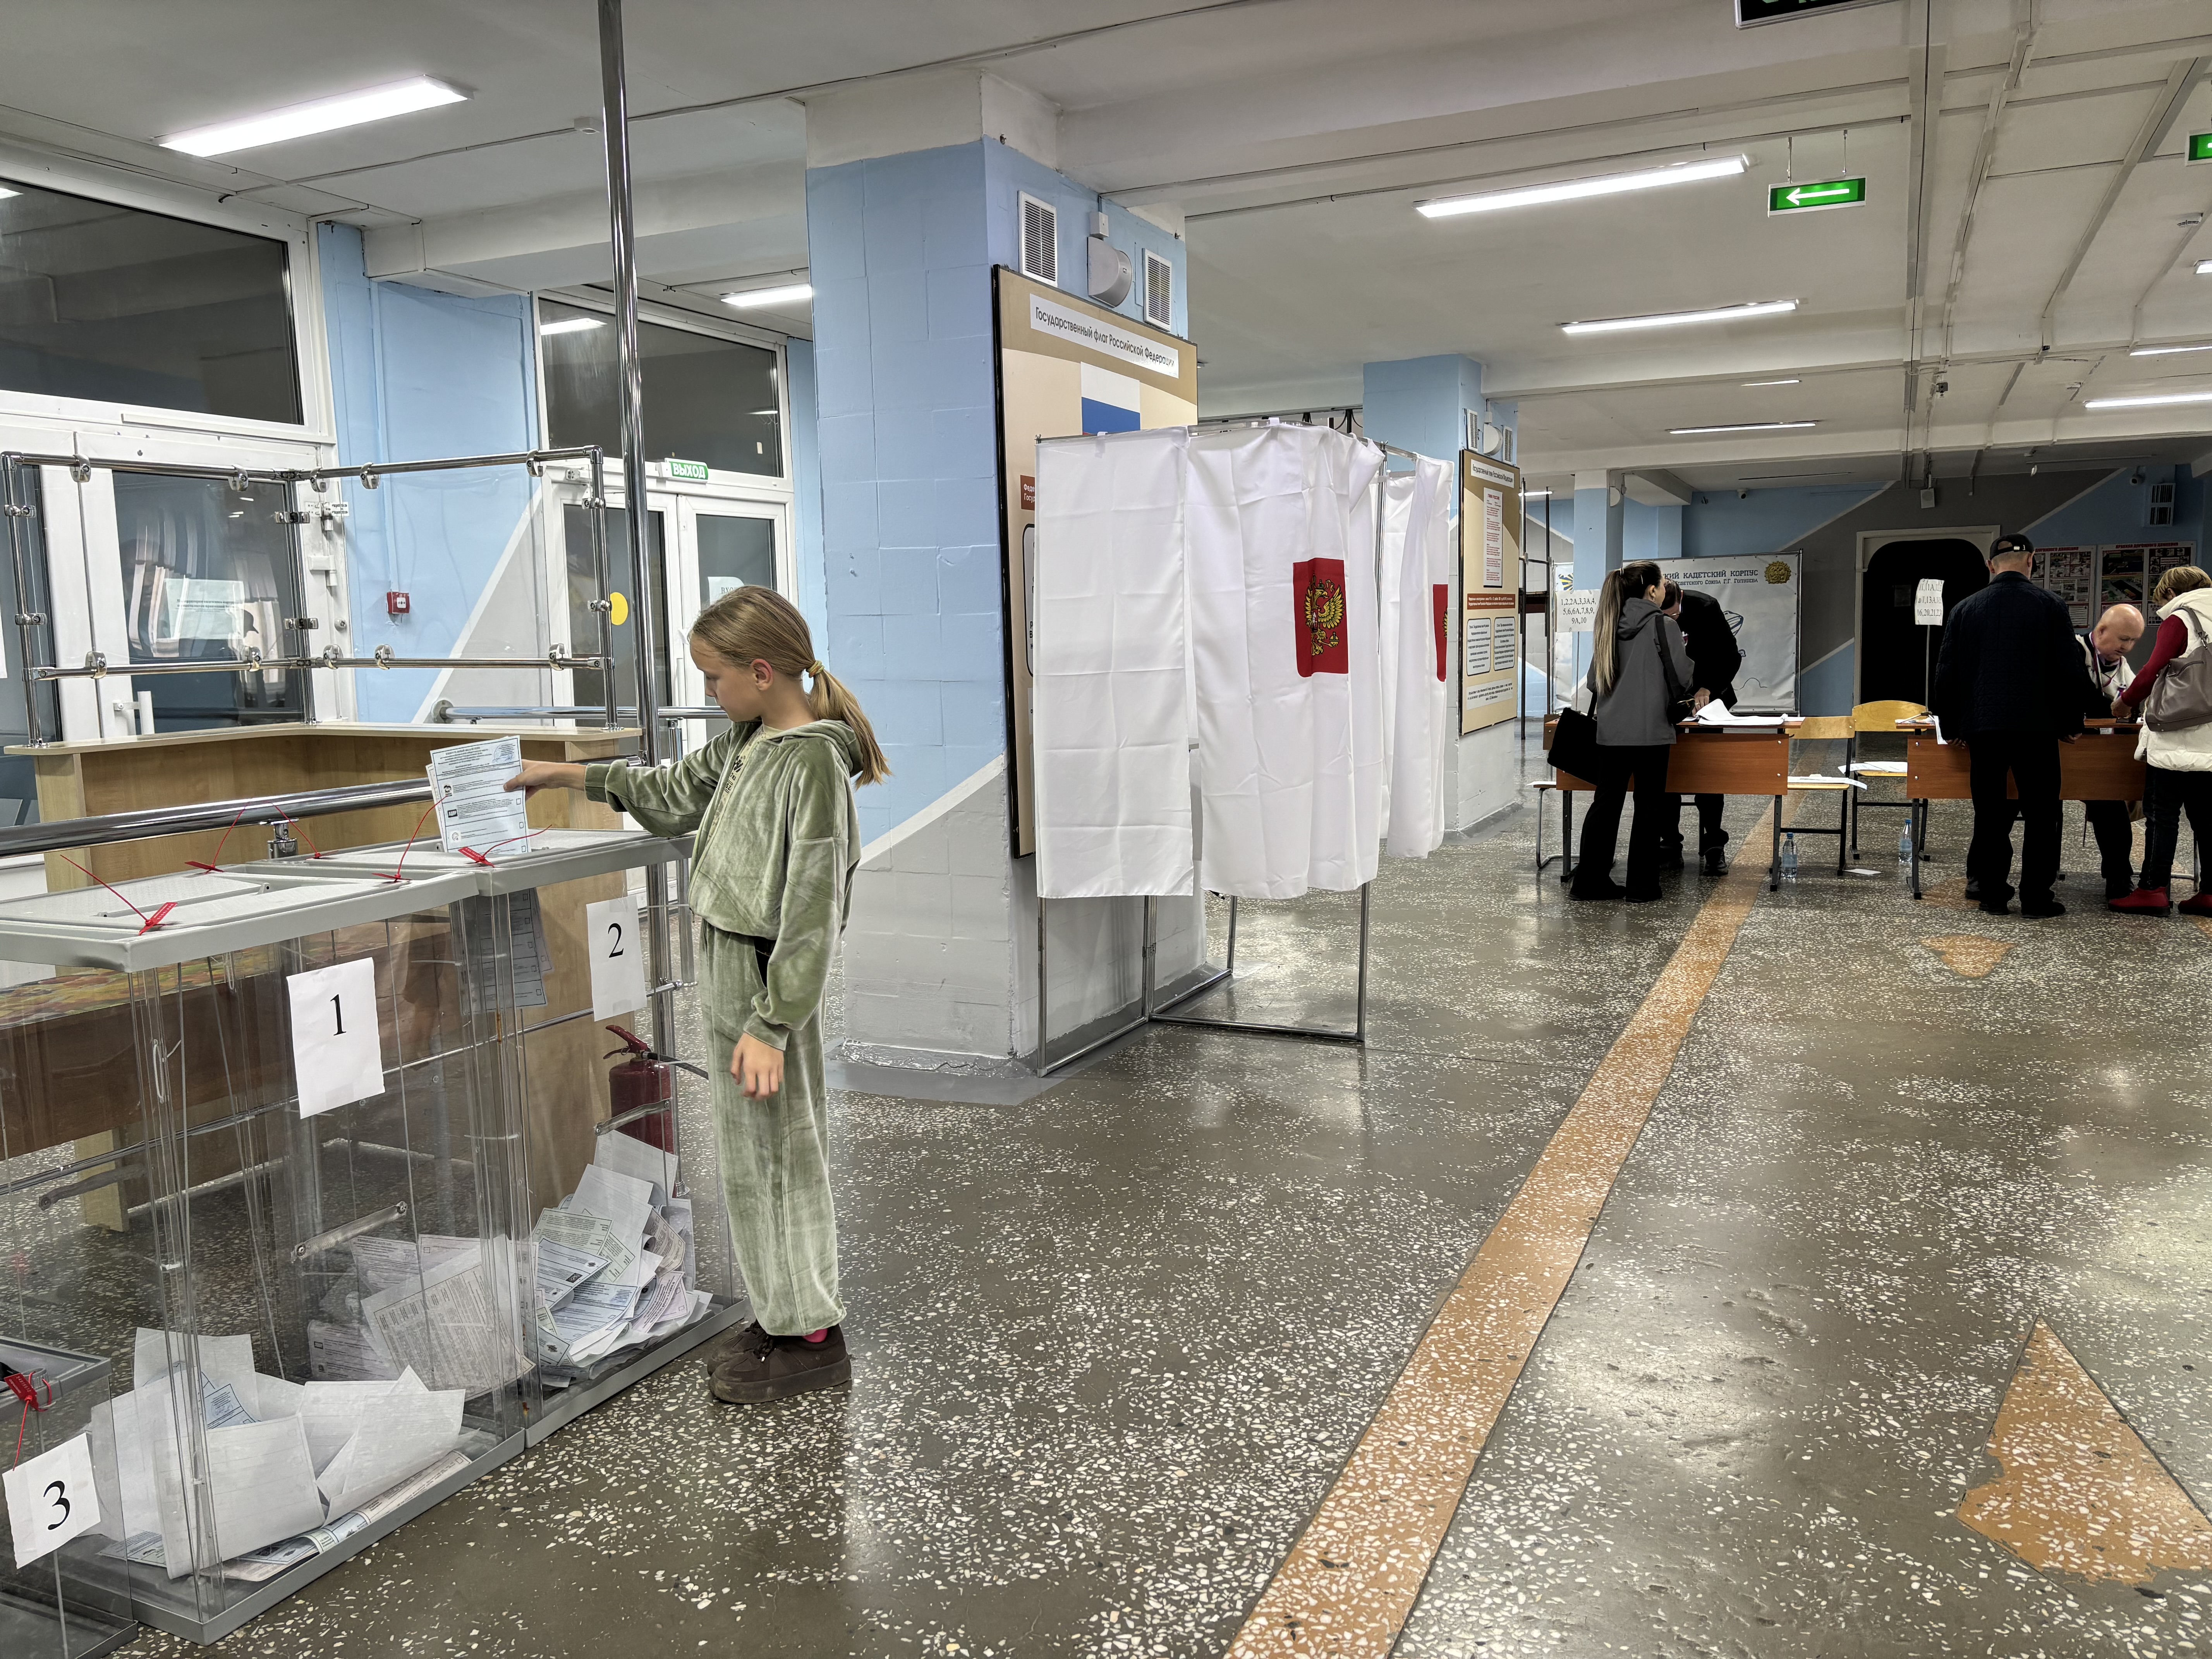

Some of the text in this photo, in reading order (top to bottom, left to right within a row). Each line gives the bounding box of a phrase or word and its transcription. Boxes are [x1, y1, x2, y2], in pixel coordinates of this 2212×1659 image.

[1036, 306, 1175, 367] Государственный флаг Российской Федерации
[672, 463, 706, 479] ВЫХОД
[1683, 570, 1726, 579] КАДЕТСКИЙ
[607, 923, 624, 958] 2
[330, 993, 347, 1036] 1
[43, 1480, 70, 1531] 3
